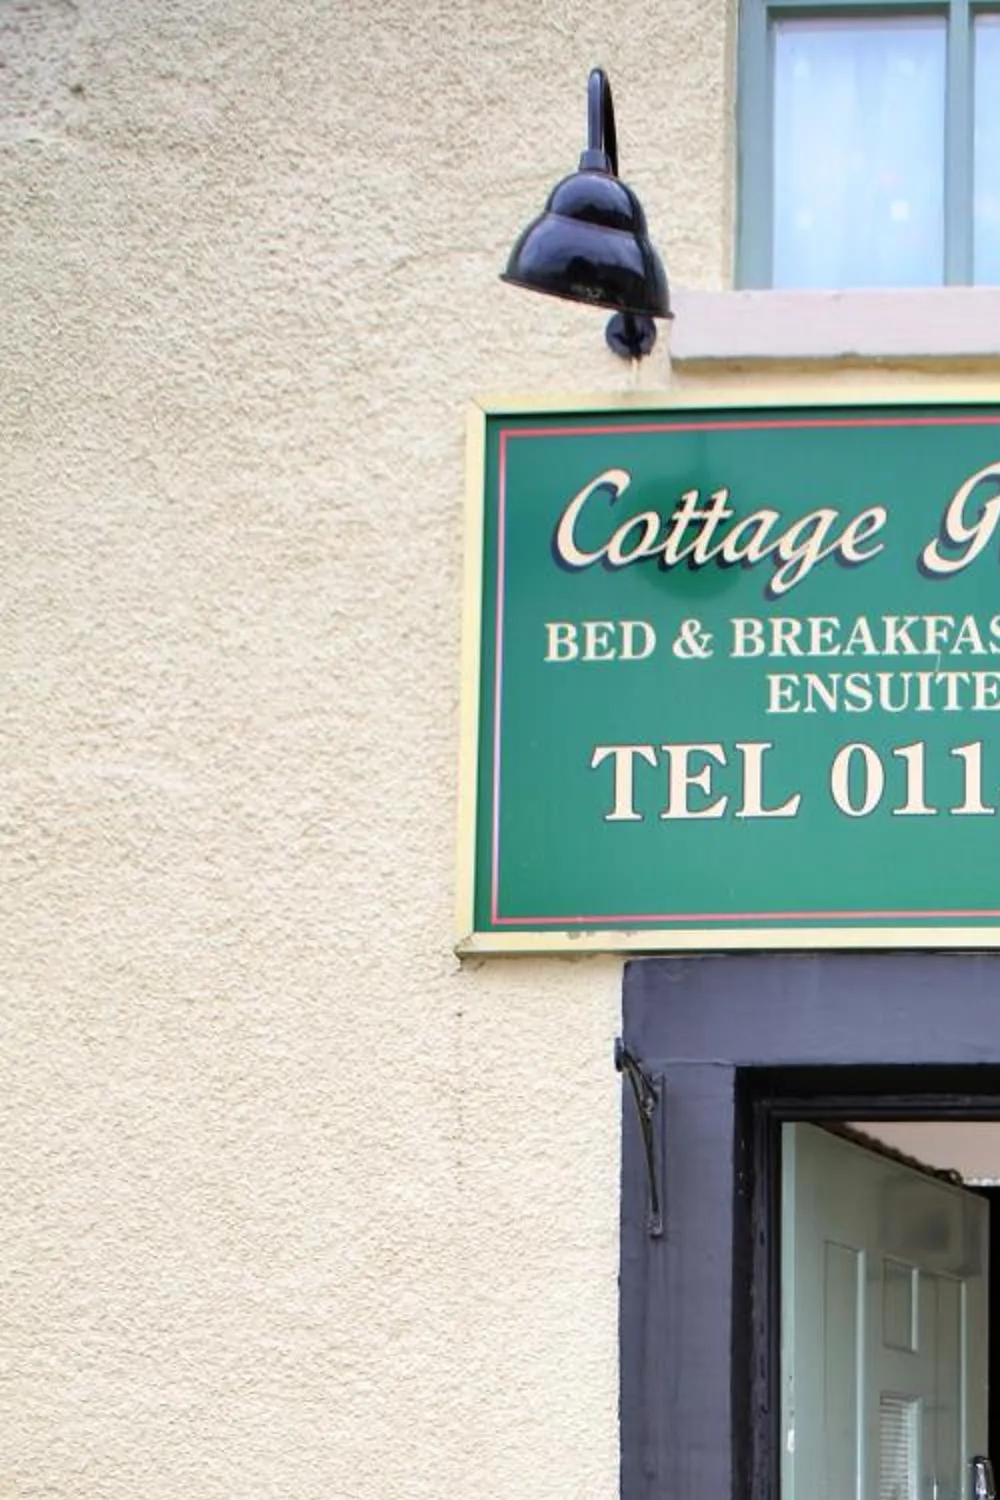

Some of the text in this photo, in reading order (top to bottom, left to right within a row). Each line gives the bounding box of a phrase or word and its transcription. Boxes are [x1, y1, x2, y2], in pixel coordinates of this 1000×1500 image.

[554, 468, 888, 600] Cottage
[544, 621, 657, 662] BED
[671, 619, 713, 660] &
[591, 743, 801, 821] TEL
